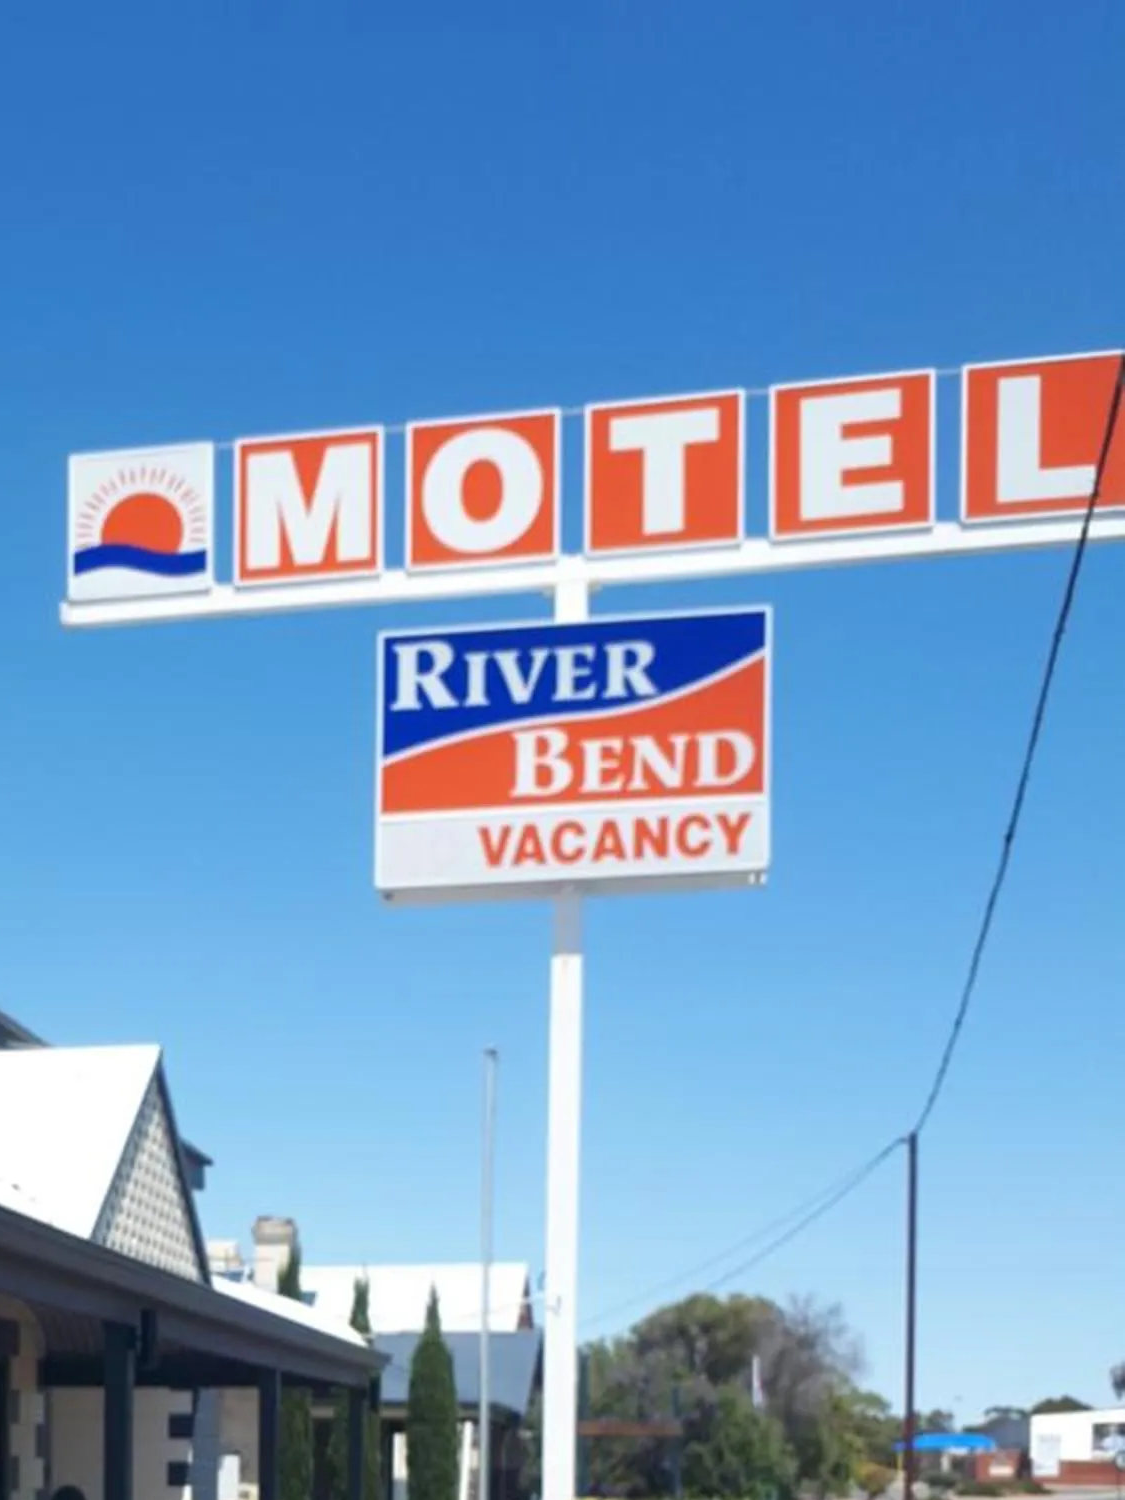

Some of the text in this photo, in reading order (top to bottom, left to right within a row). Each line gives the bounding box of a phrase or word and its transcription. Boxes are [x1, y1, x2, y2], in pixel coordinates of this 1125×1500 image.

[246, 375, 1097, 570] MOTEL
[390, 641, 657, 710] RIVER
[509, 729, 754, 799] BEND
[476, 812, 751, 868] VACANCY
